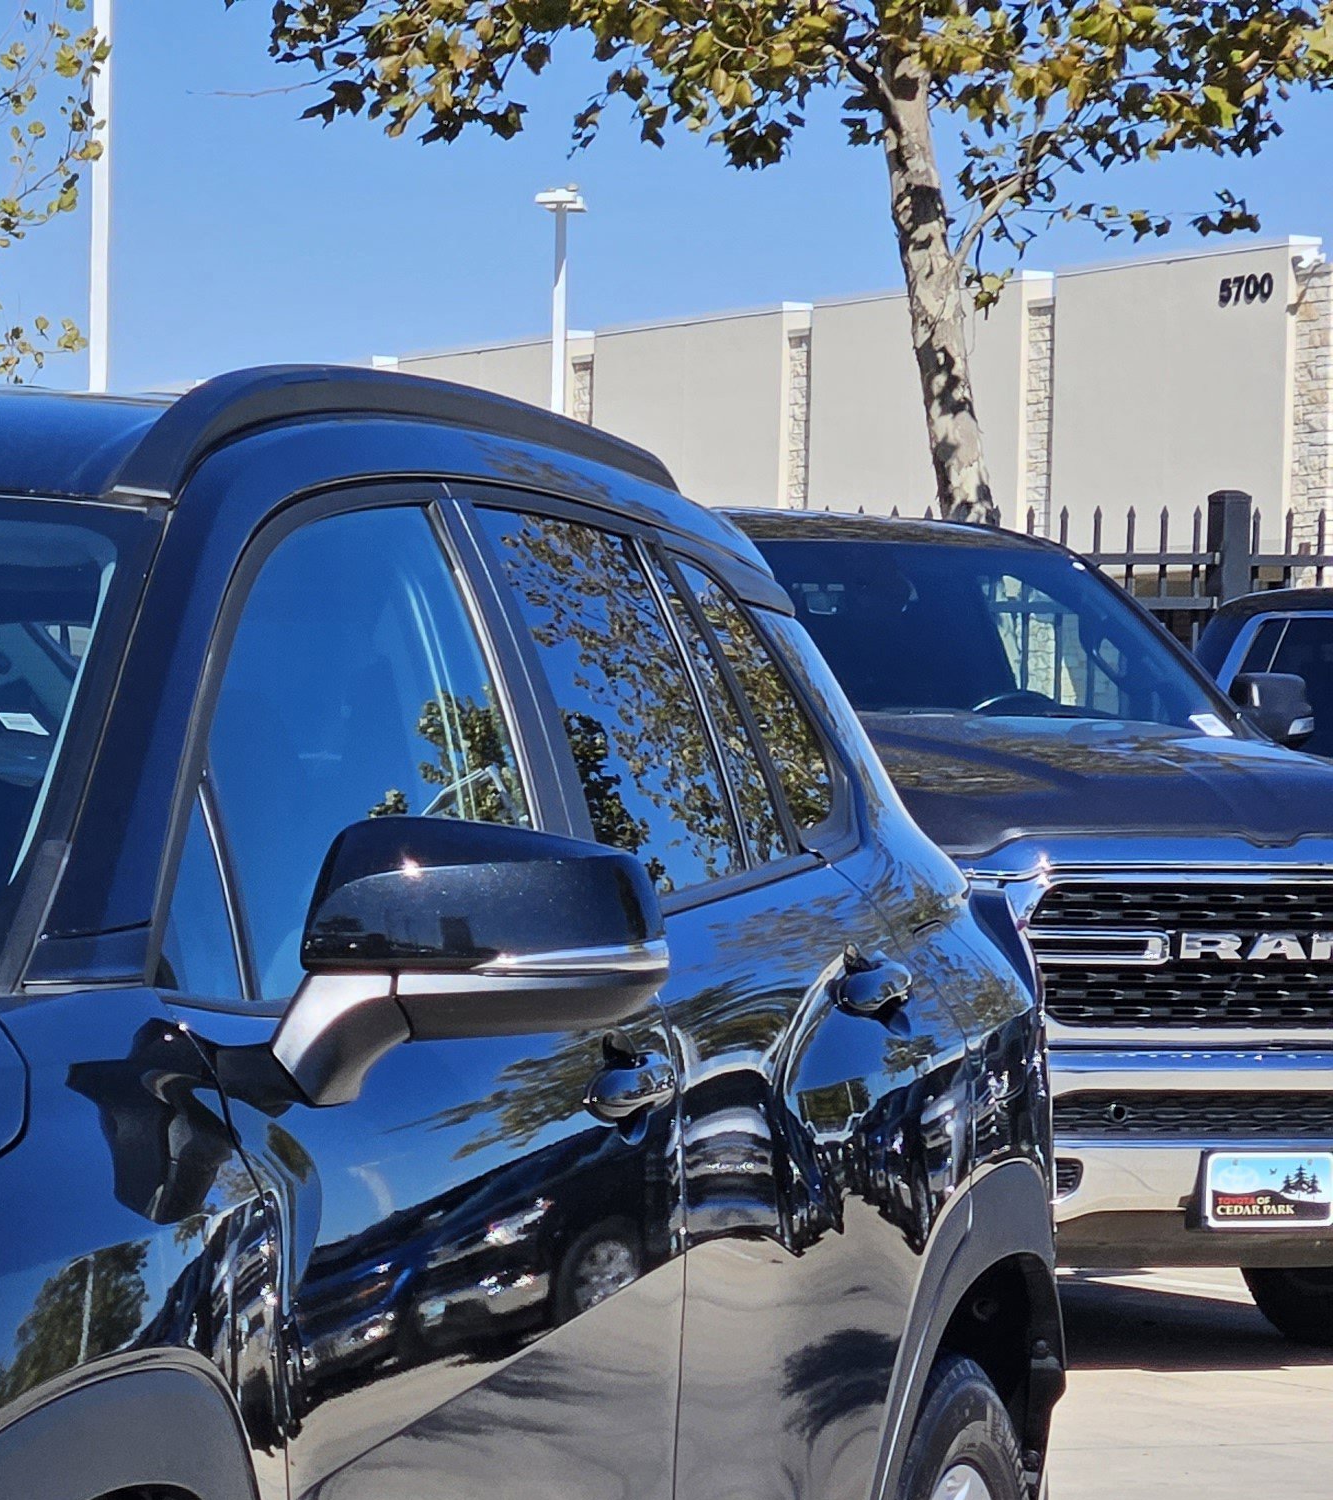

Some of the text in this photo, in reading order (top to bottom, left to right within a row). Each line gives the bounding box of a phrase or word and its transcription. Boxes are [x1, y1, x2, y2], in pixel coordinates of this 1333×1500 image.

[1218, 272, 1274, 304] 5700
[1218, 1196, 1271, 1205] TOYOTA OF
[1216, 1204, 1295, 1215] CEDAR PARK
